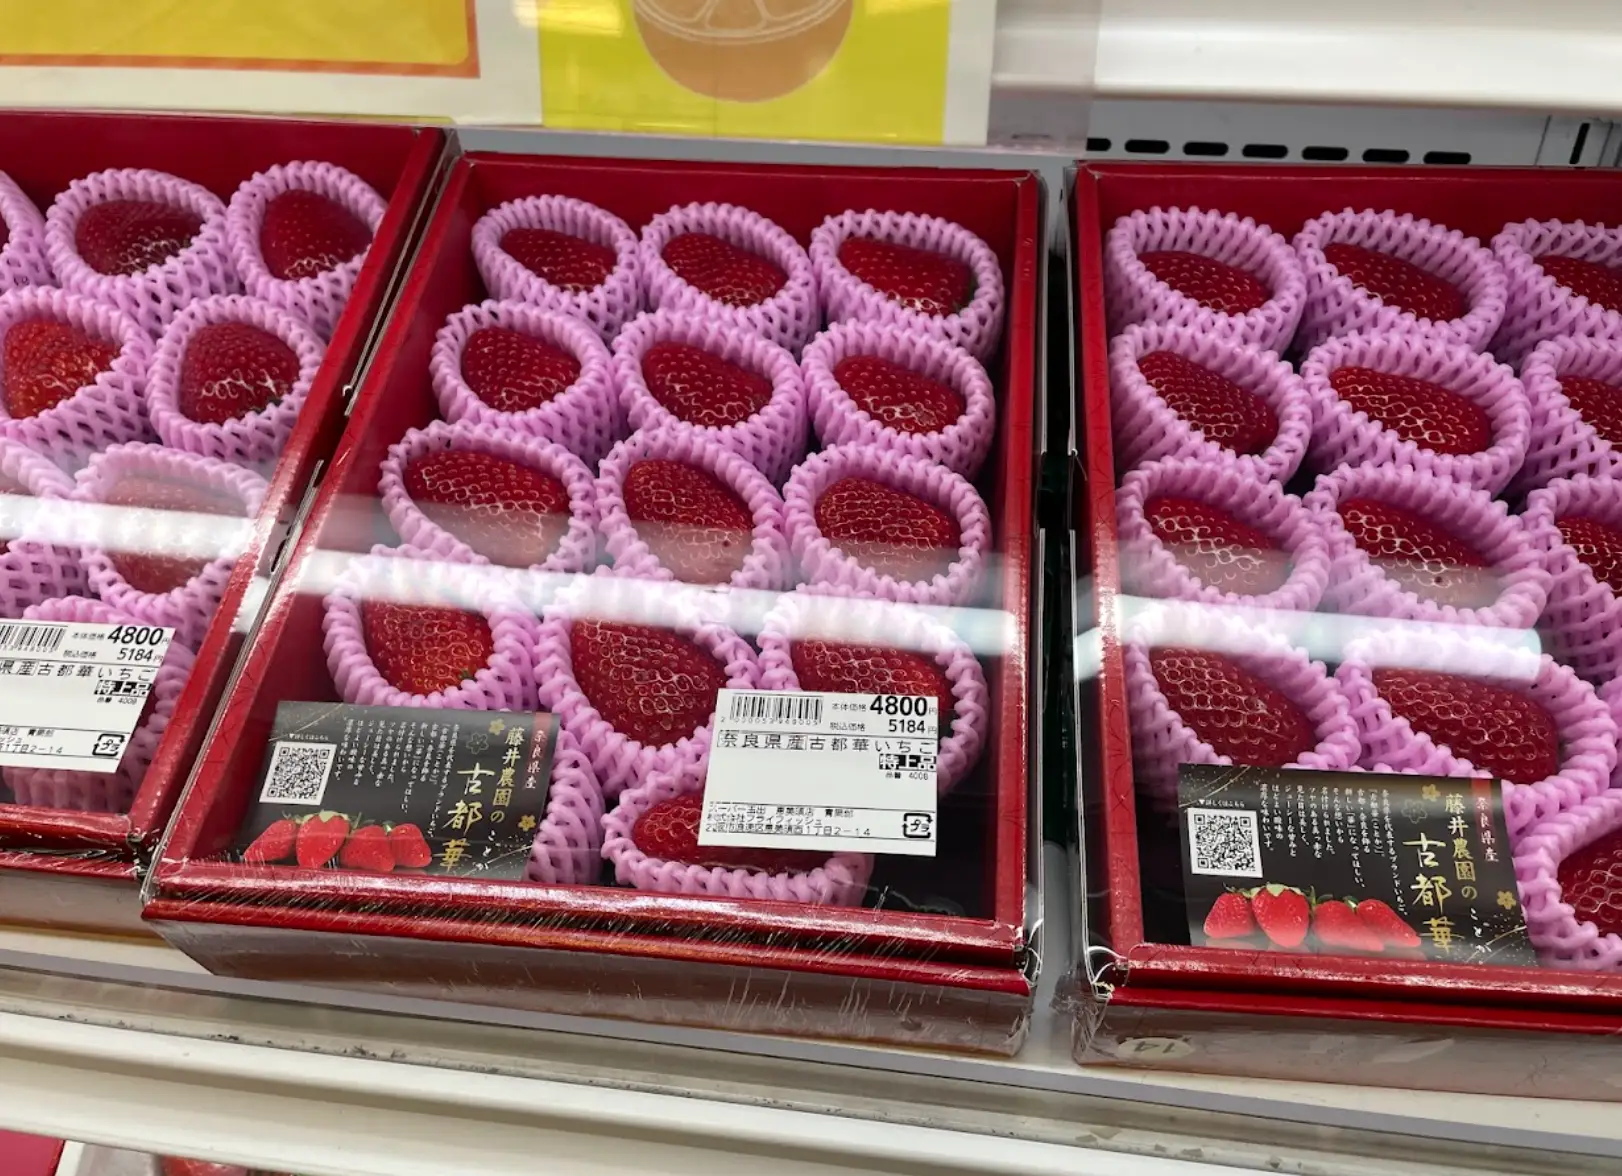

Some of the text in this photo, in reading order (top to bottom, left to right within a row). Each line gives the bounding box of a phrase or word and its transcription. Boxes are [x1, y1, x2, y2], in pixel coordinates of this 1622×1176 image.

[108, 626, 164, 646] 4800
[116, 648, 154, 662] 5184
[0, 660, 156, 682] 県産古都華いちご
[94, 680, 152, 698] 特上品
[832, 696, 937, 716] 本体価格 4800 円
[830, 718, 937, 734] 税込価格 5184 円
[720, 733, 935, 754] 奈良県産古都華いちご
[523, 729, 549, 791] 奈良県産
[879, 754, 936, 772] 特上品
[488, 726, 525, 824] 藤井農園の
[1205, 800, 1245, 808] 詳しくはこちら
[432, 762, 496, 873] 古都華
[1474, 795, 1499, 863] 奈良県産
[1444, 793, 1477, 901] 藤井農園の
[1402, 832, 1466, 954] 古都華
[1134, 1041, 1177, 1054] 14
